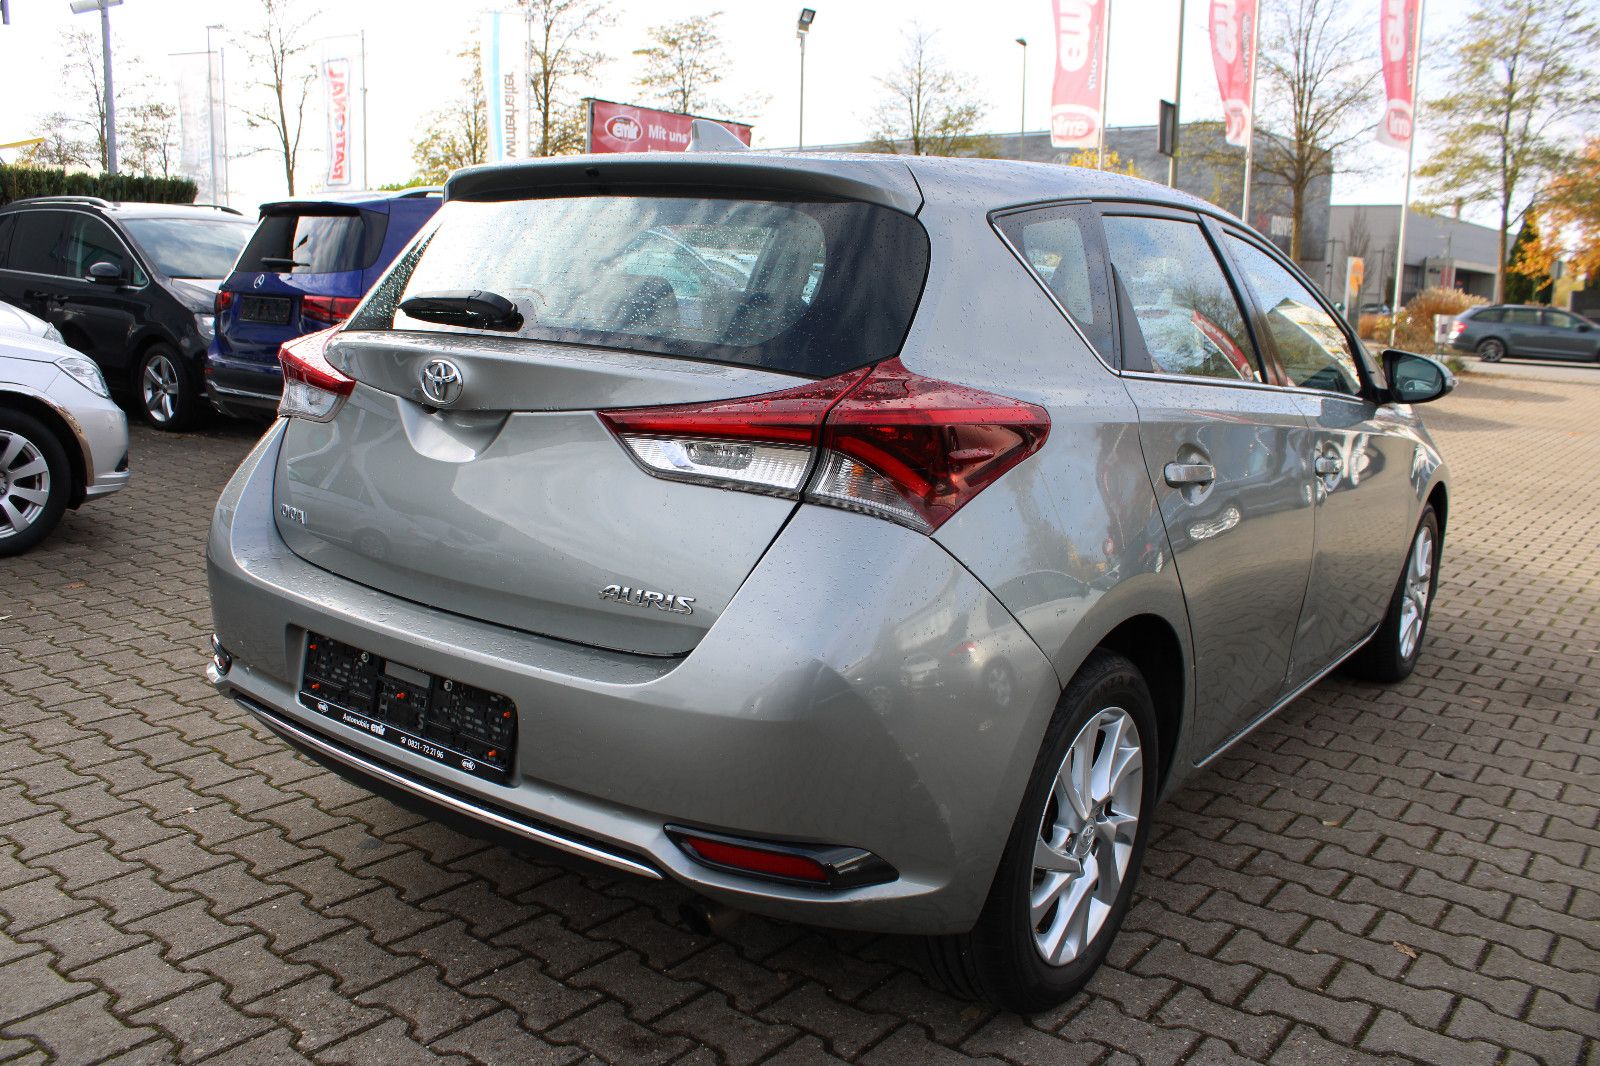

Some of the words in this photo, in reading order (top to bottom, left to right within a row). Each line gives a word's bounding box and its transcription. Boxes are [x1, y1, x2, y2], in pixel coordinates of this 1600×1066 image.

[612, 121, 639, 140] emir
[648, 124, 667, 140] Mit
[669, 131, 688, 144] uns
[598, 584, 696, 615] AURIS
[342, 713, 370, 730] Automobile
[370, 724, 386, 736] emir
